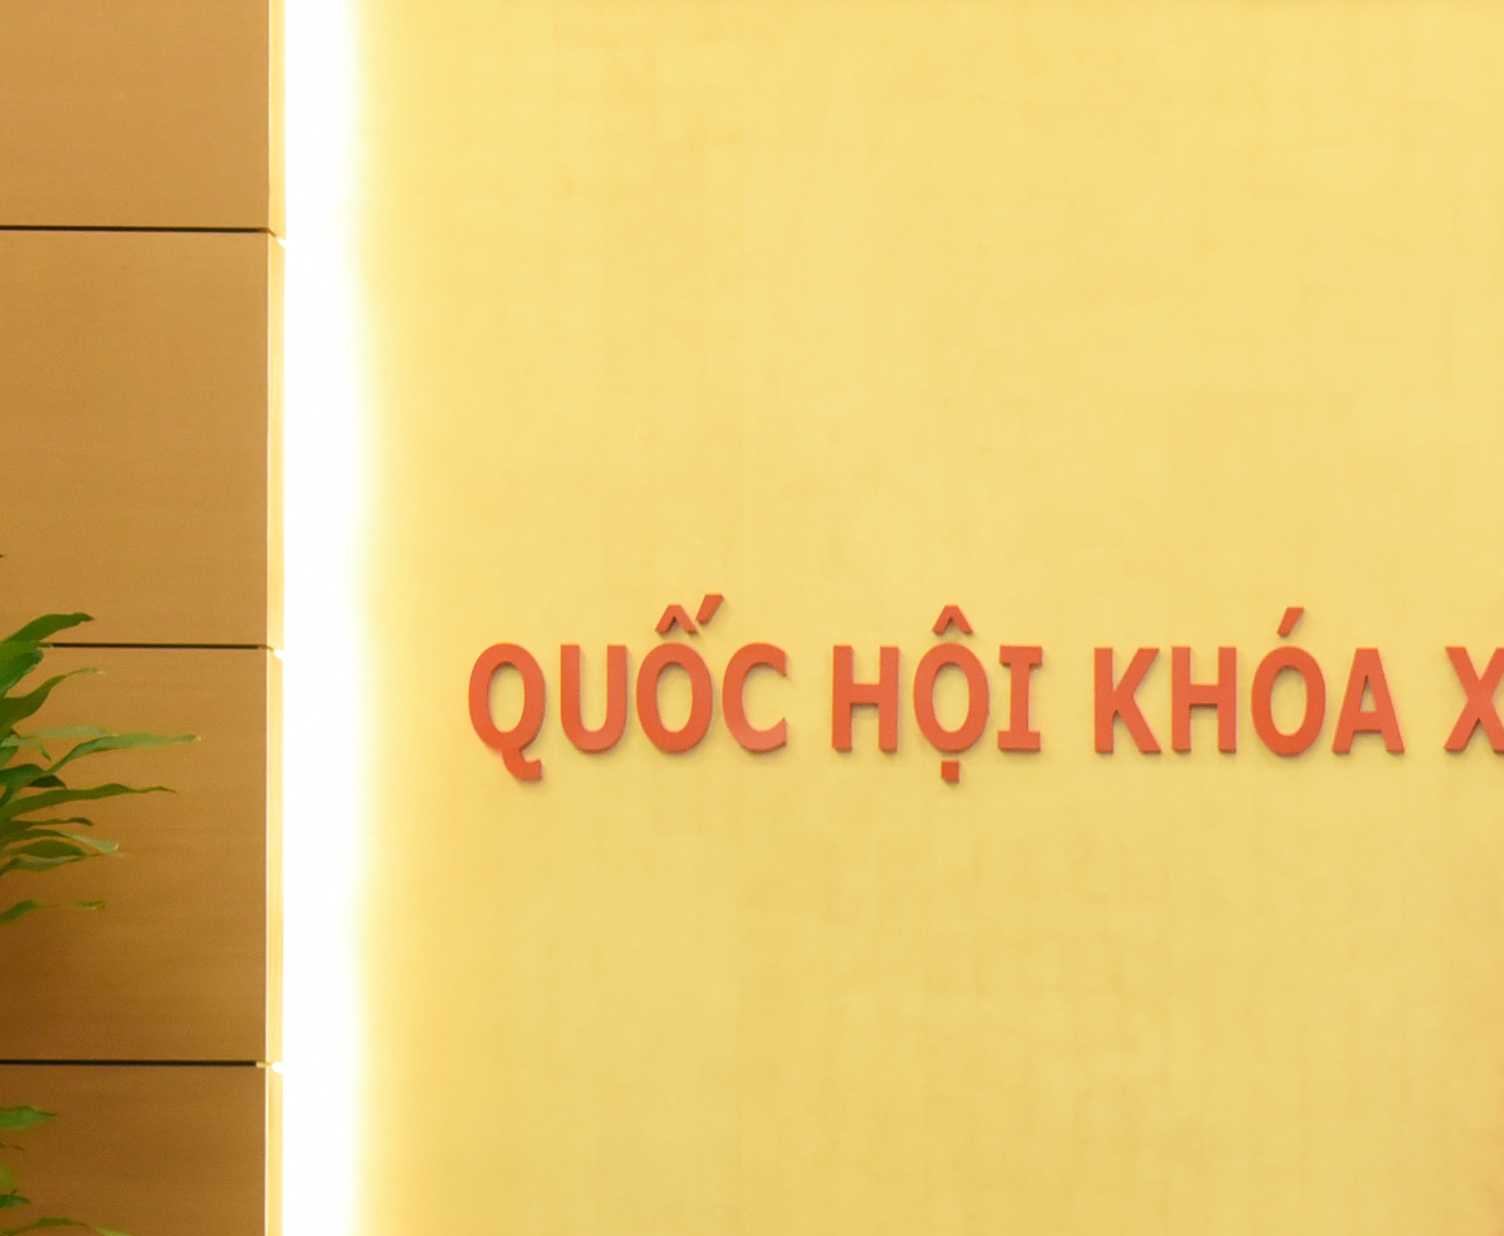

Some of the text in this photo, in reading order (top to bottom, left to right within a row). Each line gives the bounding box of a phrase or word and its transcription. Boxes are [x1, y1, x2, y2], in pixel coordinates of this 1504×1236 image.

[469, 594, 787, 780] QUỐC
[832, 605, 1043, 781] HỘI
[1094, 607, 1405, 755] KHÓA
